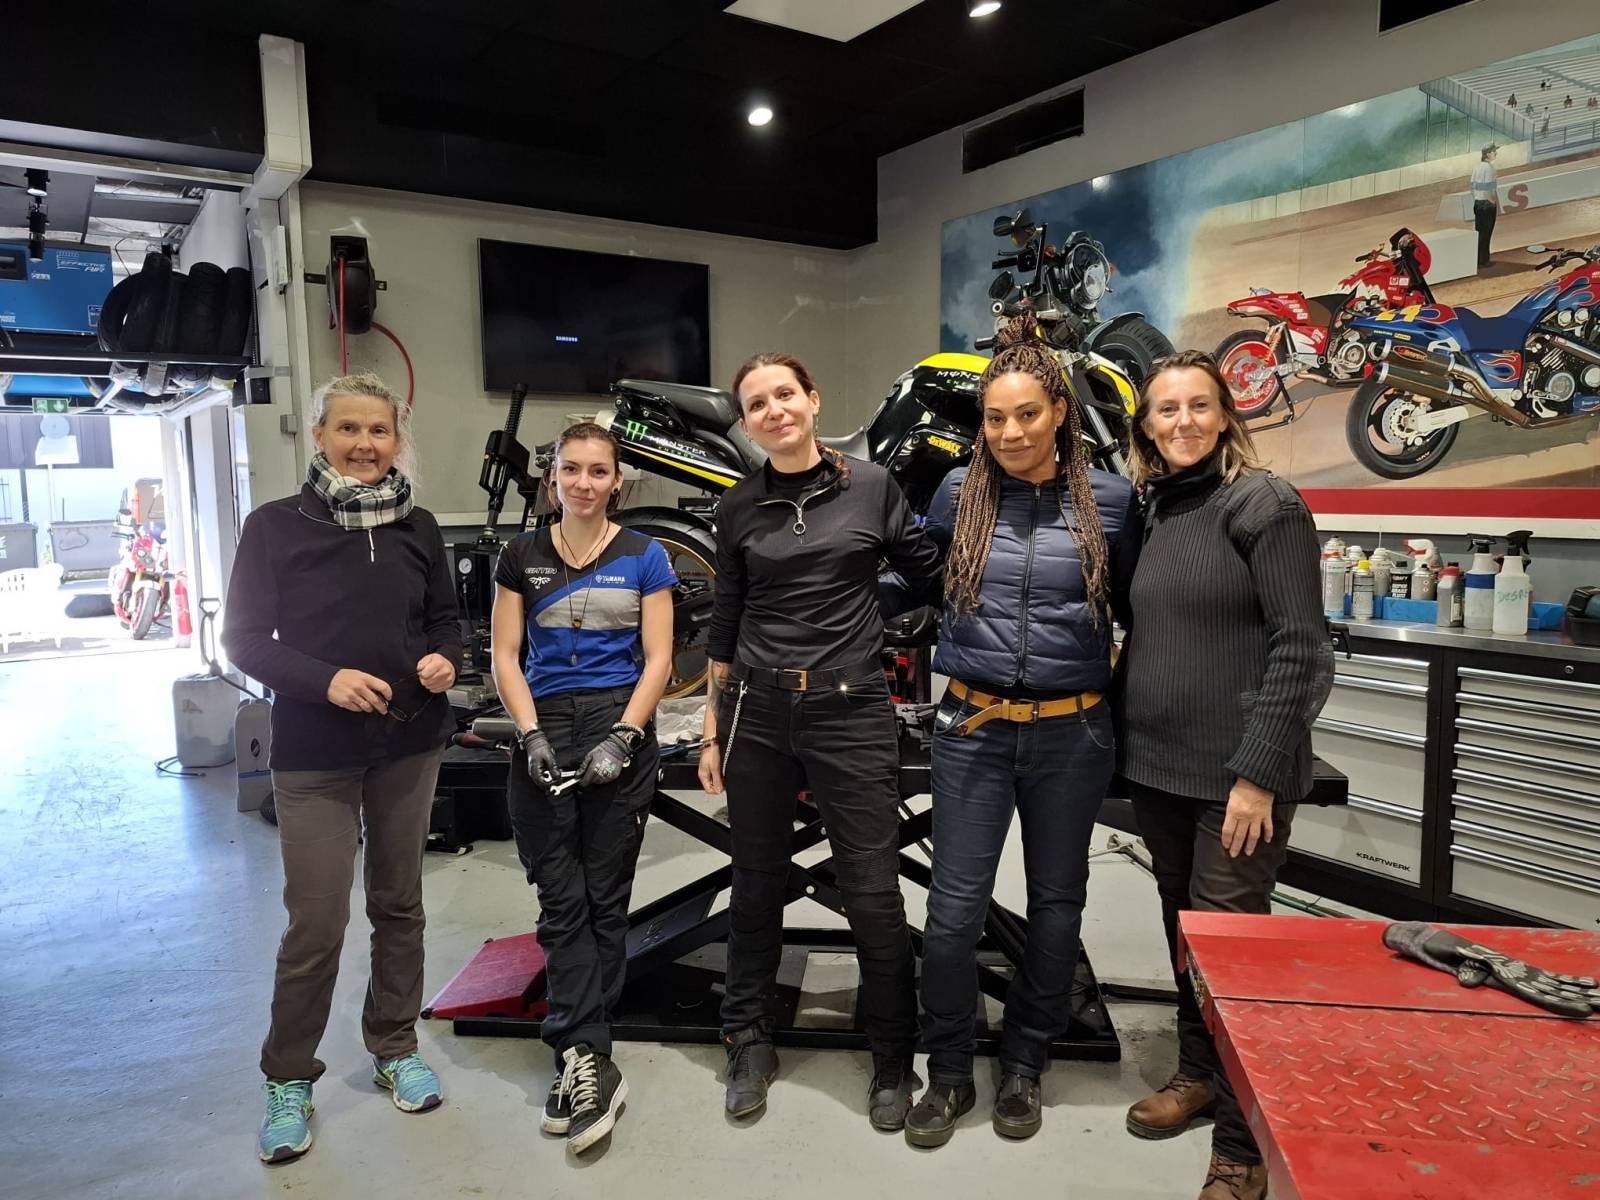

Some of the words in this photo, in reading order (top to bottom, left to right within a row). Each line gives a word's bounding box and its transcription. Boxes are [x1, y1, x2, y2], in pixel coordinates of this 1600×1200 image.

[555, 335, 578, 343] SAMSUNG
[602, 575, 626, 583] YAMAHA
[1356, 852, 1411, 871] KRAFTWERK
